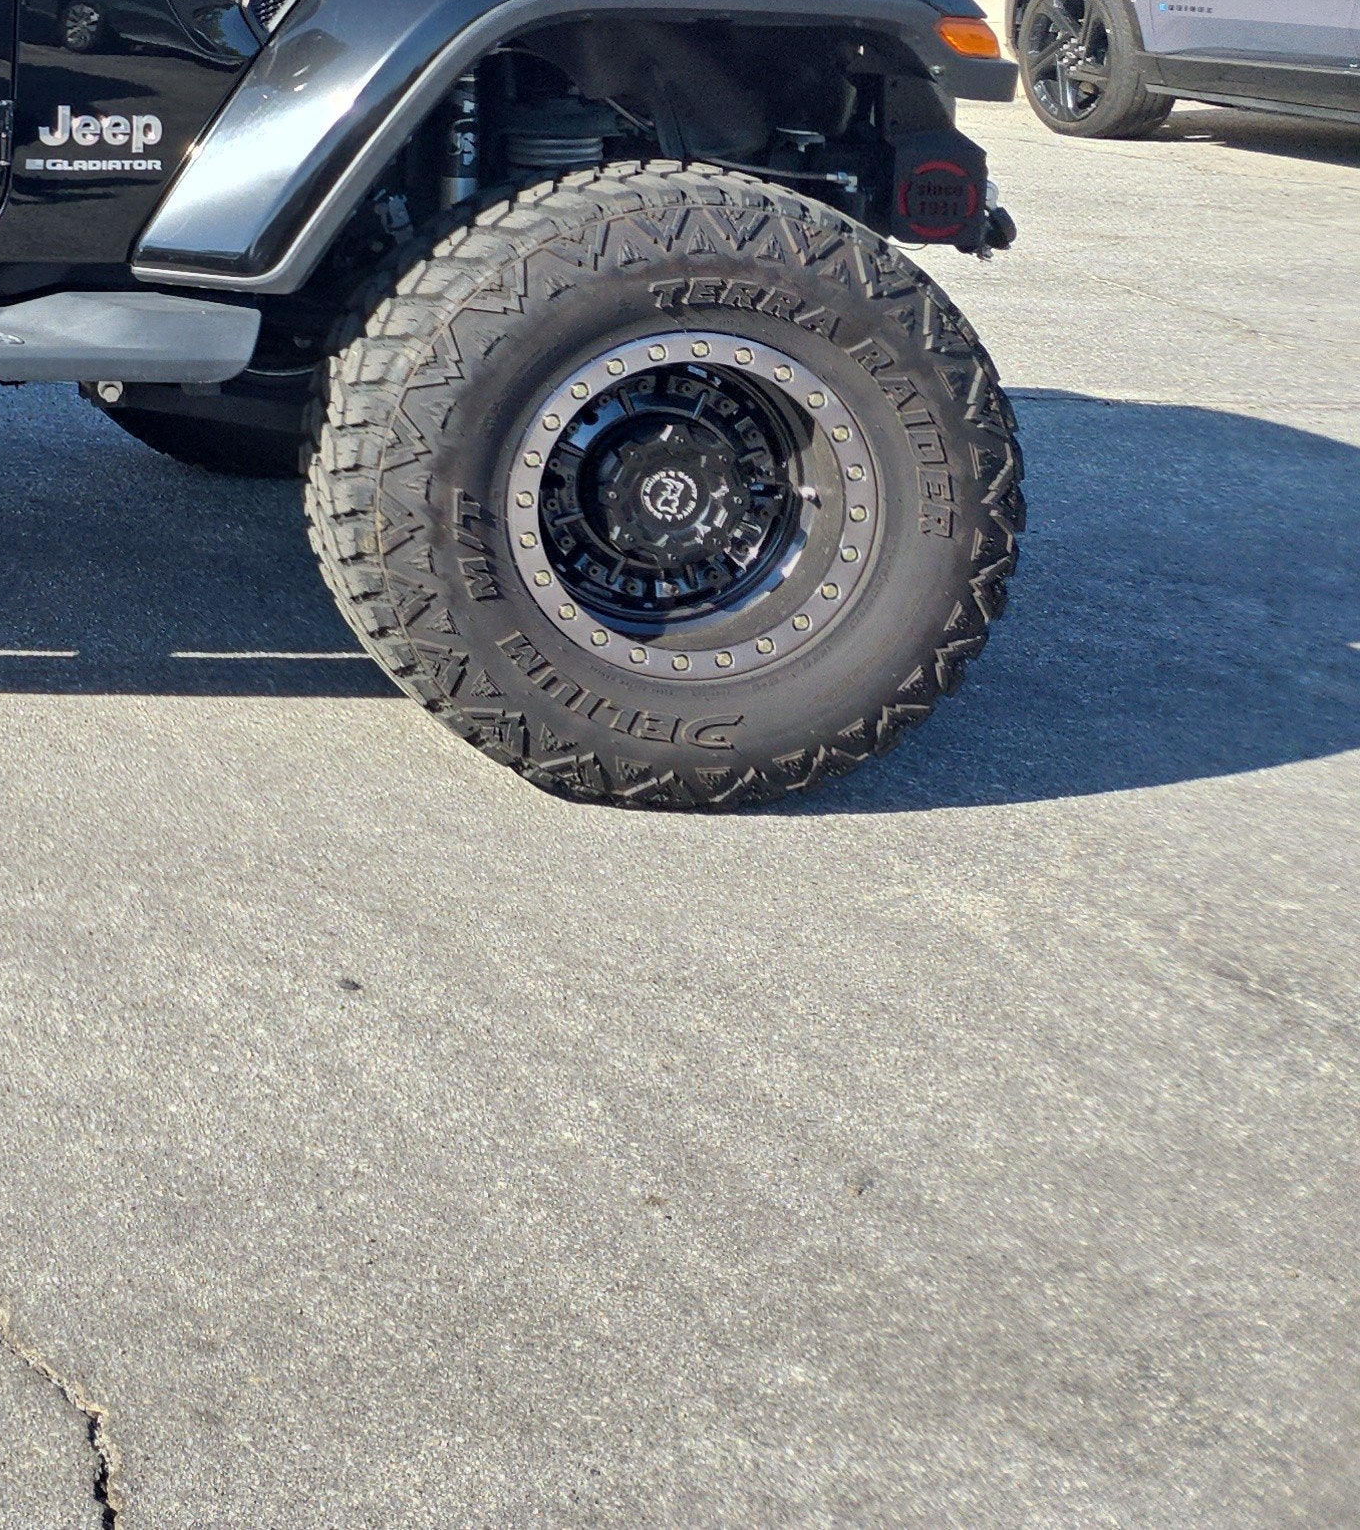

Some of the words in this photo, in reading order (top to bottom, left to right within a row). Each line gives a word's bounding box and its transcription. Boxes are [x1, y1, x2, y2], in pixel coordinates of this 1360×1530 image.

[38, 105, 163, 153] Jeep
[45, 159, 162, 171] GLADIATOR
[649, 276, 840, 341] TERRA
[847, 338, 955, 538] RAIDER
[496, 631, 745, 750] DELIUM
